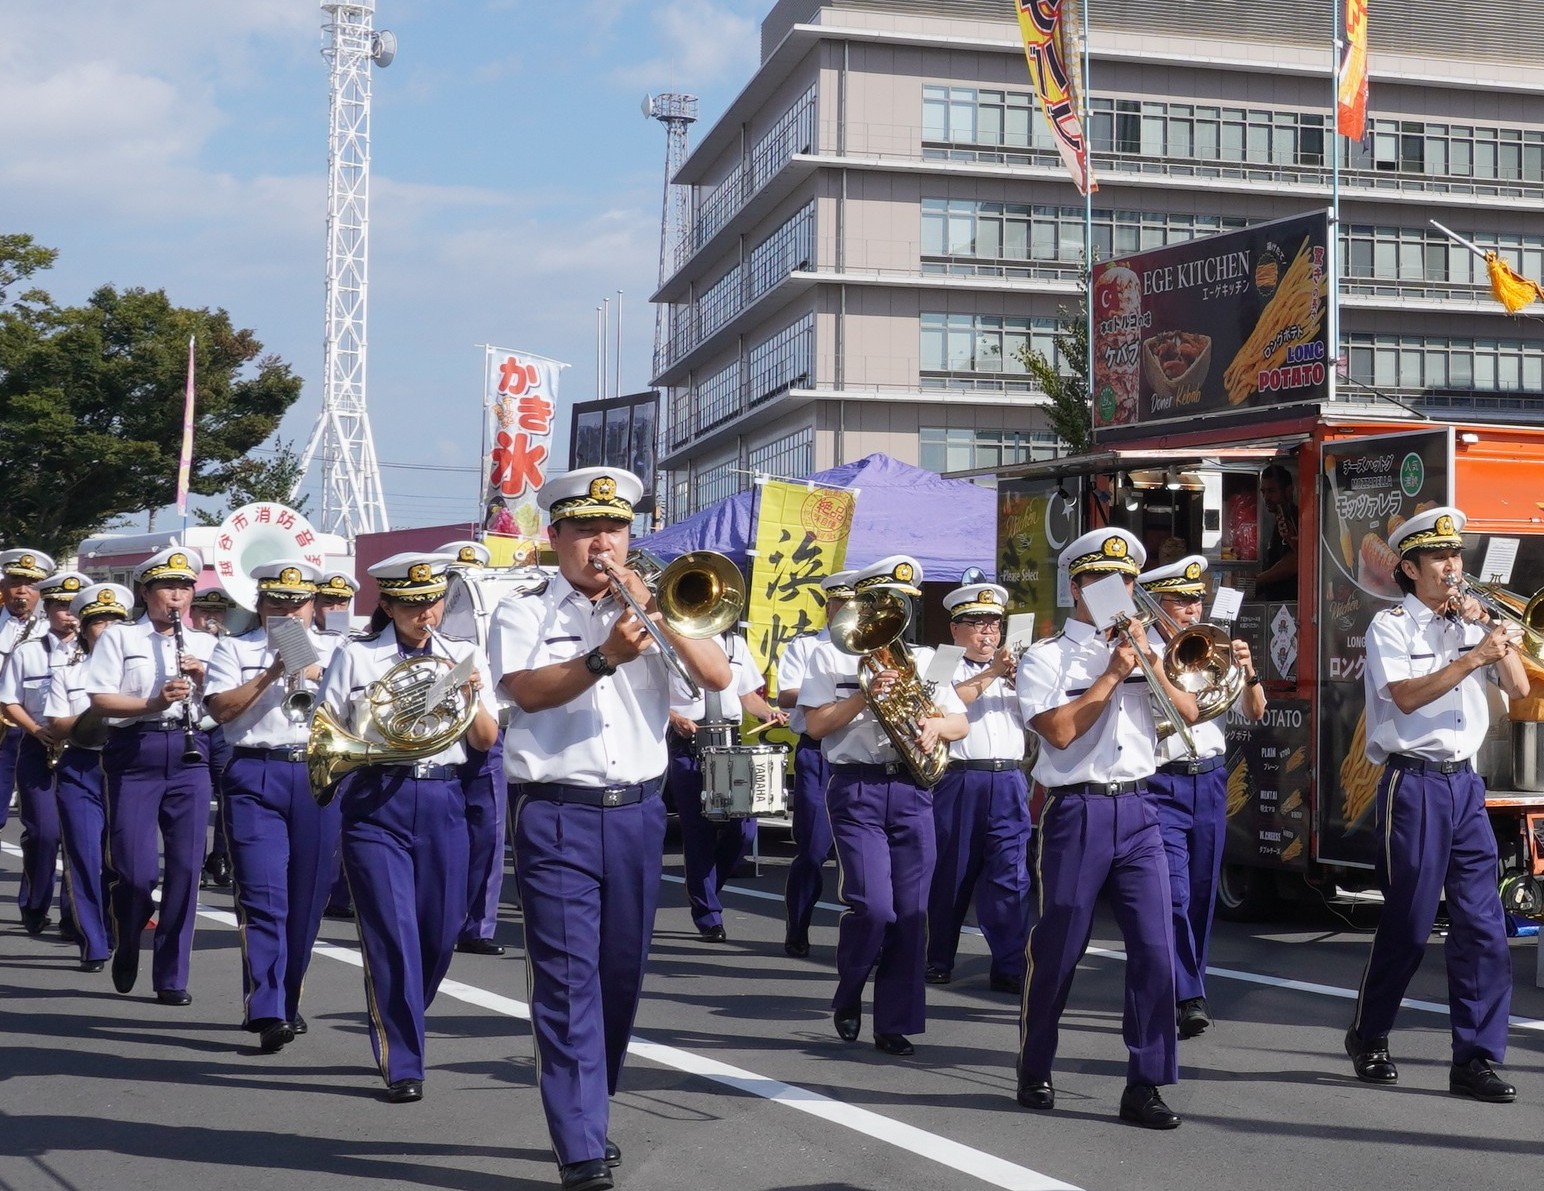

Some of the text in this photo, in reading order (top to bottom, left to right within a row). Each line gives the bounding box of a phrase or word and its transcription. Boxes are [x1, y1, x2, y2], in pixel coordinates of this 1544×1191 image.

[1143, 251, 1251, 295] EGE KITCHEN
[1202, 280, 1250, 300] エーゲキッチン
[1105, 342, 1140, 368] ケバブ
[1263, 323, 1304, 359] ロングポテト
[1258, 362, 1325, 392] POTATO
[489, 355, 555, 498] かき氷
[1335, 490, 1402, 520] モッツァレラ
[1226, 709, 1302, 728] ONG OTATO
[1225, 730, 1252, 742] ングポテト
[756, 763, 766, 802] YAMAHA
